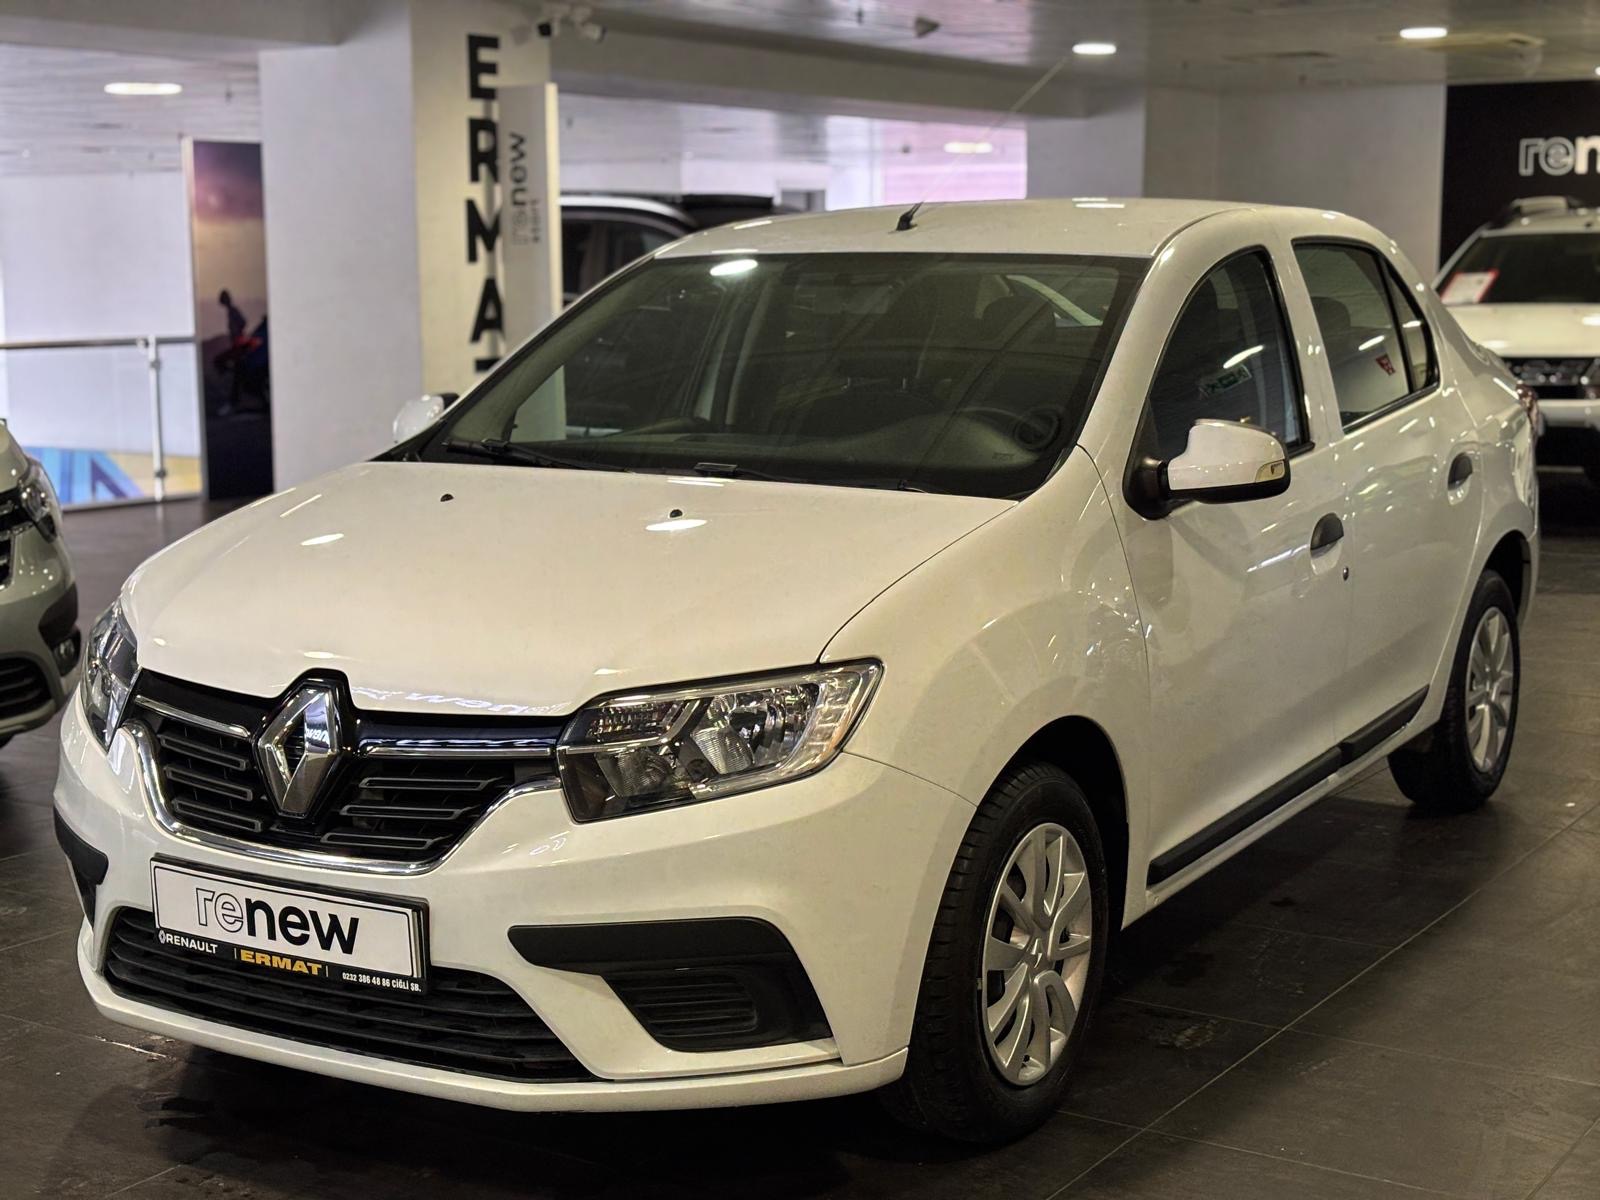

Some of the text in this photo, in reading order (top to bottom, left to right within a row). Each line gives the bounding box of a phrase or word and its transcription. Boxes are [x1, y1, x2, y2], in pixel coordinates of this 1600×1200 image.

[195, 887, 360, 955] renew
[166, 933, 218, 954] RENAULT
[240, 948, 322, 976] ERMAT
[342, 972, 358, 982] 0232
[371, 976, 381, 986] 48
